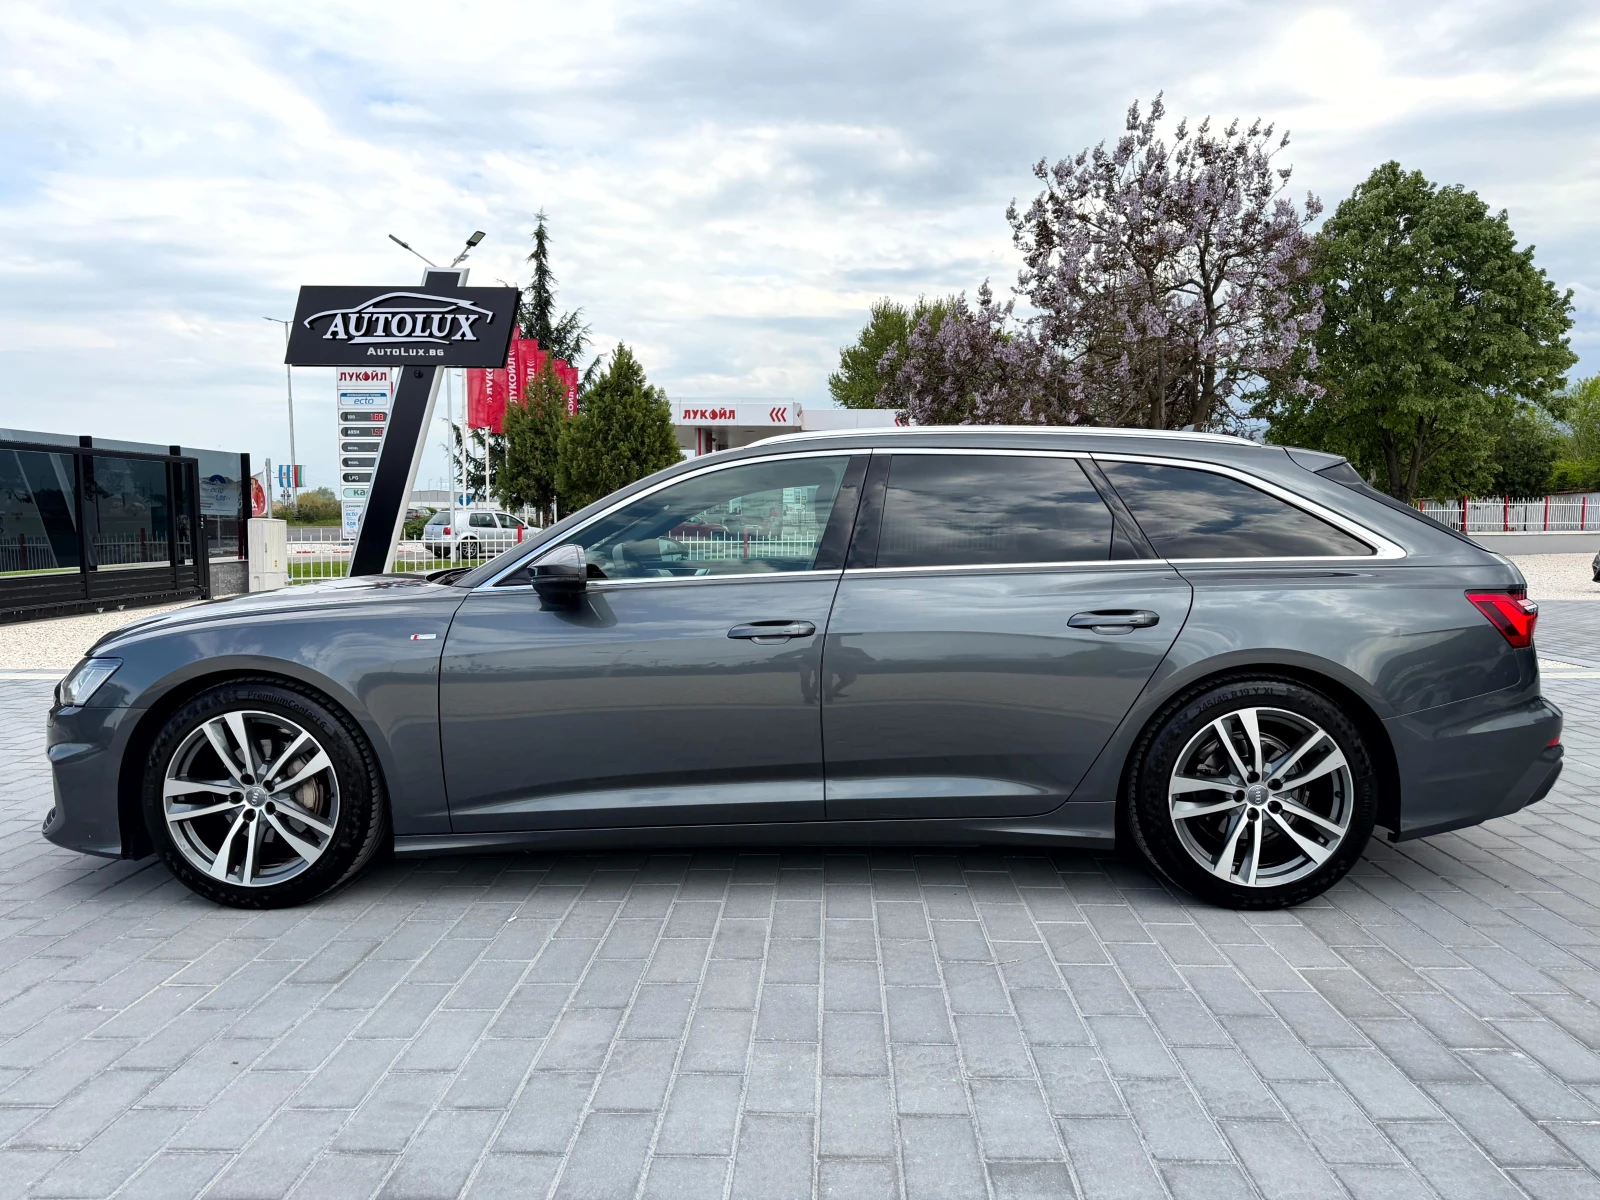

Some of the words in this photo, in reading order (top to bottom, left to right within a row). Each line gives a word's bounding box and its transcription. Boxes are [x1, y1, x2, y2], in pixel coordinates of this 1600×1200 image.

[323, 313, 478, 340] AUTOLUX
[338, 370, 387, 382] ЛУКОЙЛ
[486, 368, 494, 395] ЛУК
[507, 357, 518, 403] ЛУКОЙЛ
[353, 397, 375, 405] ecto
[682, 407, 736, 421] ЛУКОЙЛ
[248, 691, 320, 722] PremiumContact
